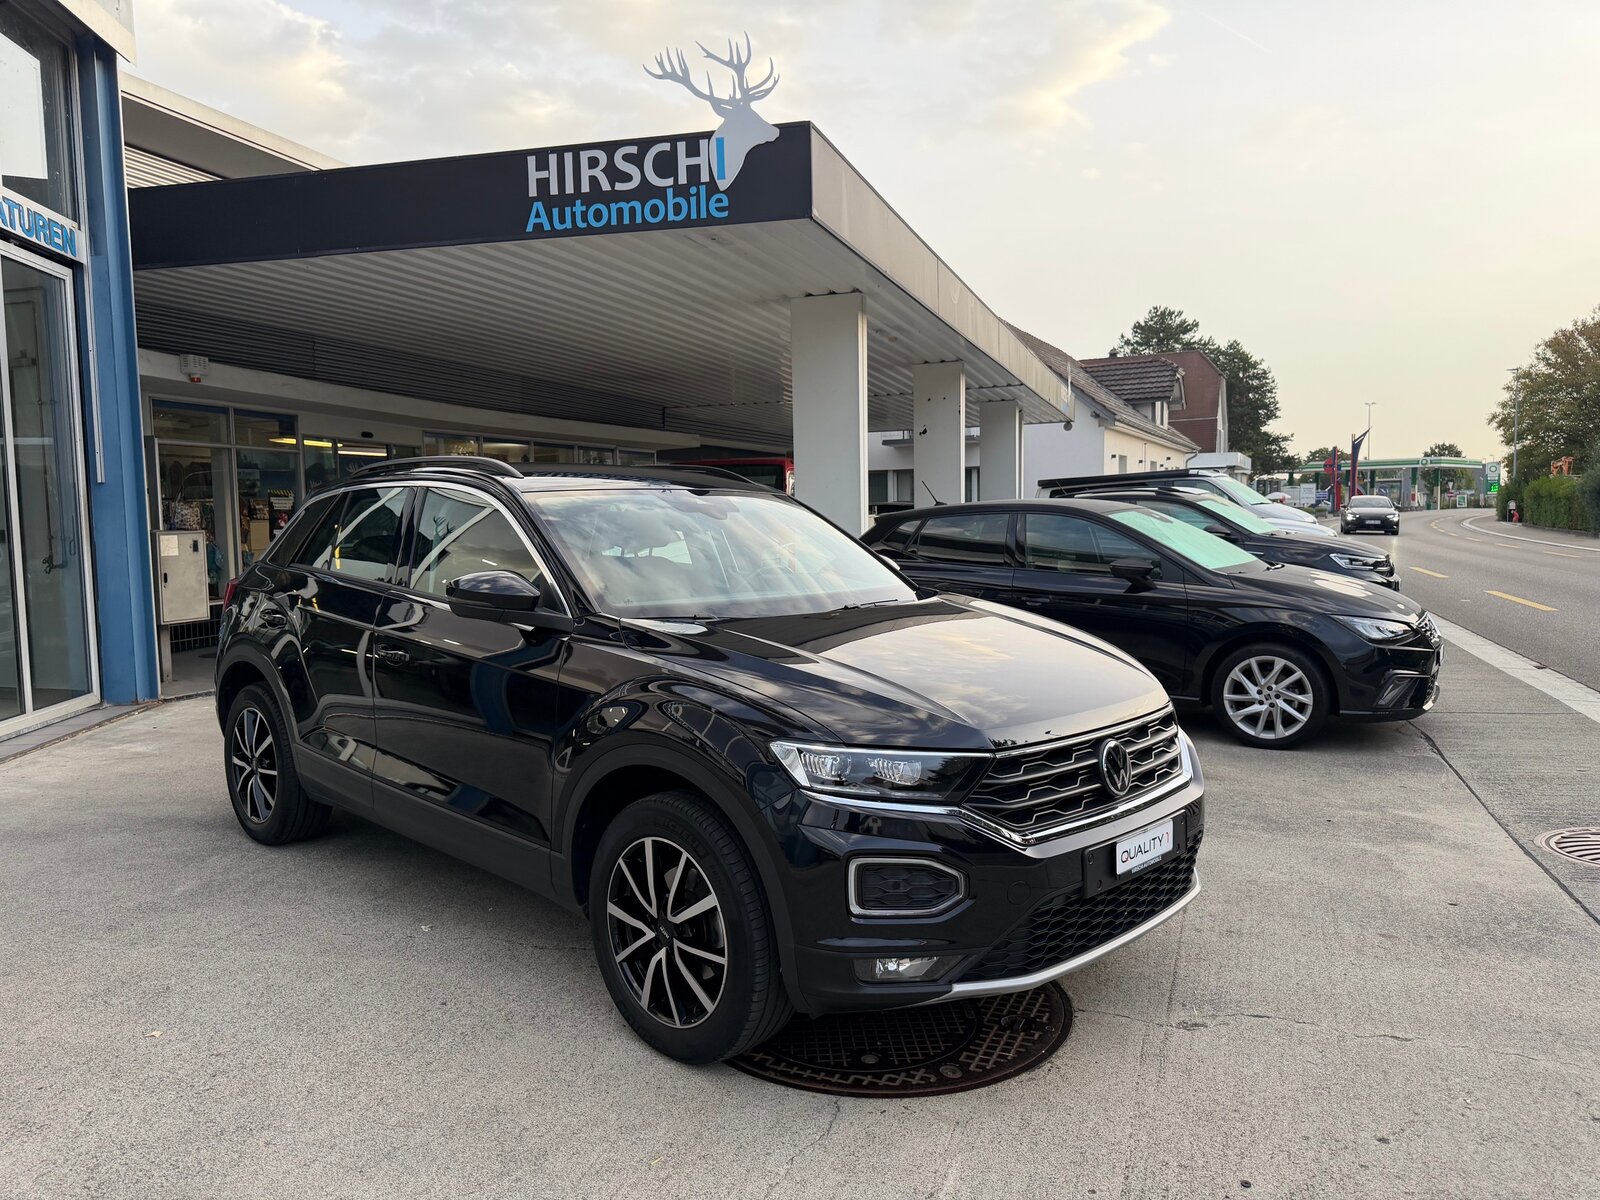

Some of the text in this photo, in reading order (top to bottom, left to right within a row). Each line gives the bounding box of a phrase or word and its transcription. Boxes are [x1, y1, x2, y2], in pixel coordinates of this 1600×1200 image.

[527, 137, 726, 198] HIRSCHI
[526, 185, 729, 232] Automobile
[1120, 833, 1164, 863] QUALITY
